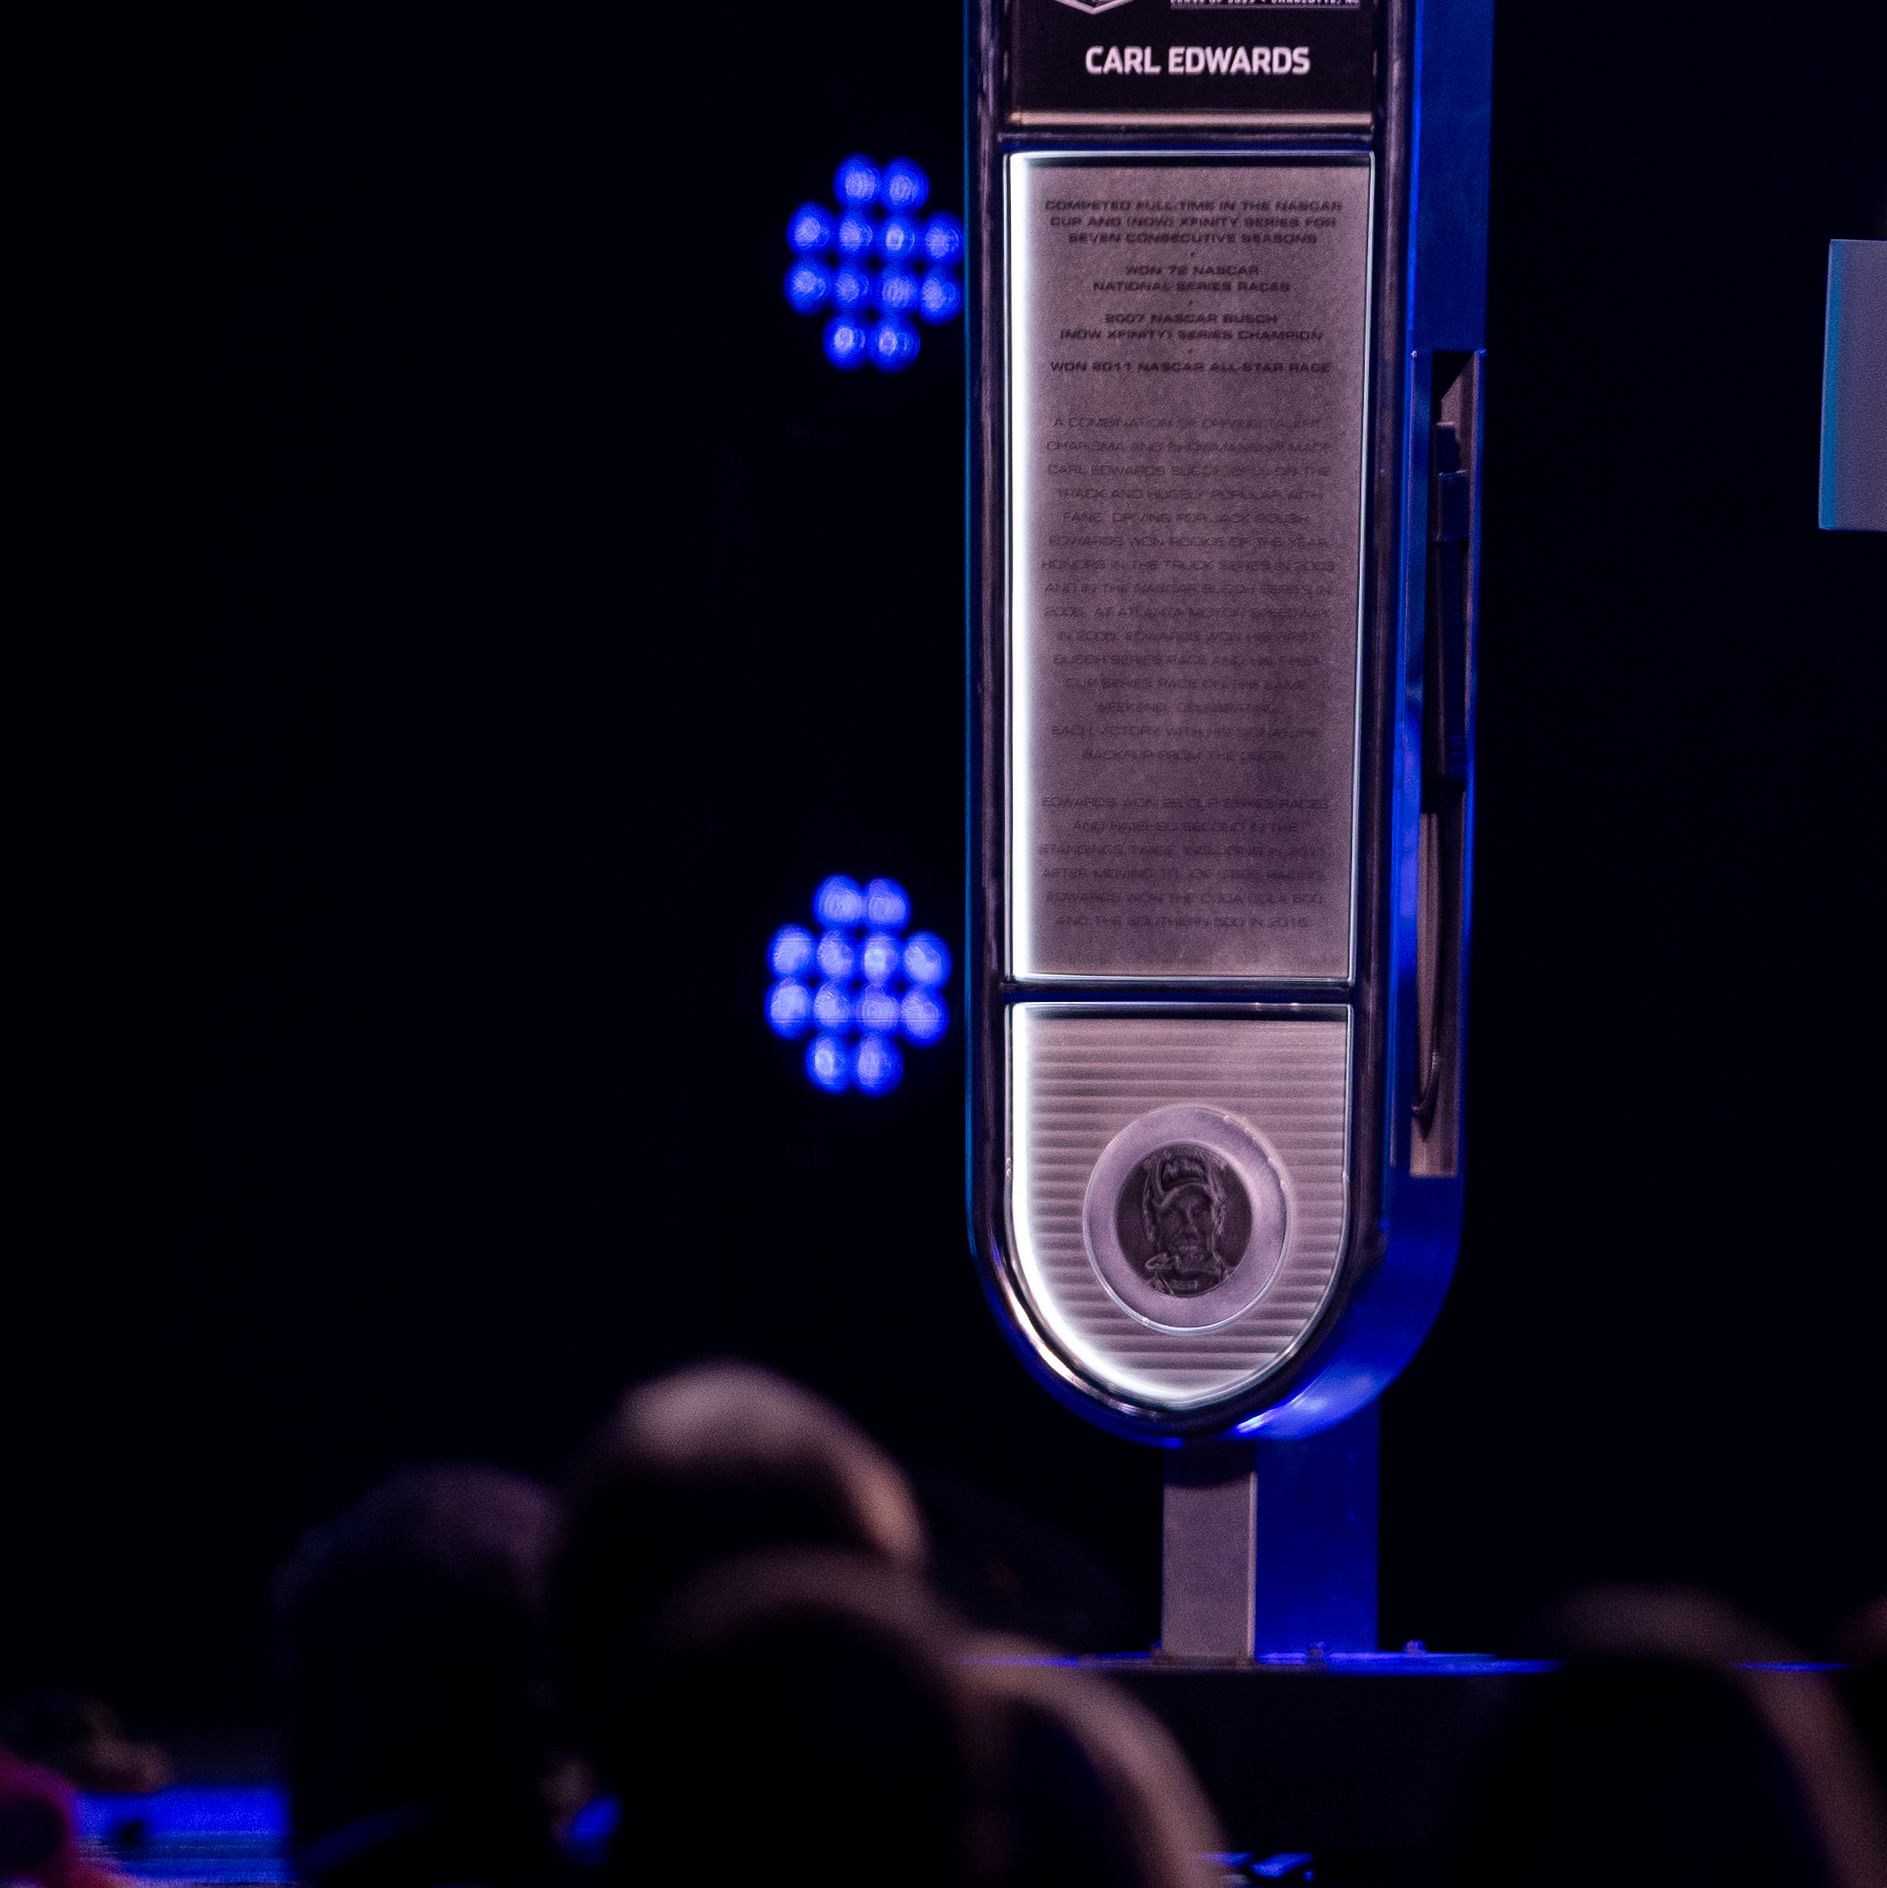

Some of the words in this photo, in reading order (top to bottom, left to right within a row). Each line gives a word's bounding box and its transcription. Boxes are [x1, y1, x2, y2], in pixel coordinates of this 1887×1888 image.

[1085, 45, 1162, 74] CARL
[1168, 46, 1311, 75] EDWARDS
[1275, 200, 1343, 212] NASCAR
[1125, 233, 1236, 244] CONSECUTIVE
[1193, 265, 1259, 276] NASCAR
[1093, 281, 1172, 292] NATIONAL
[1150, 314, 1218, 324] NASCAR
[1238, 329, 1324, 341] CHAMPION
[1137, 361, 1205, 373] NASCAR
